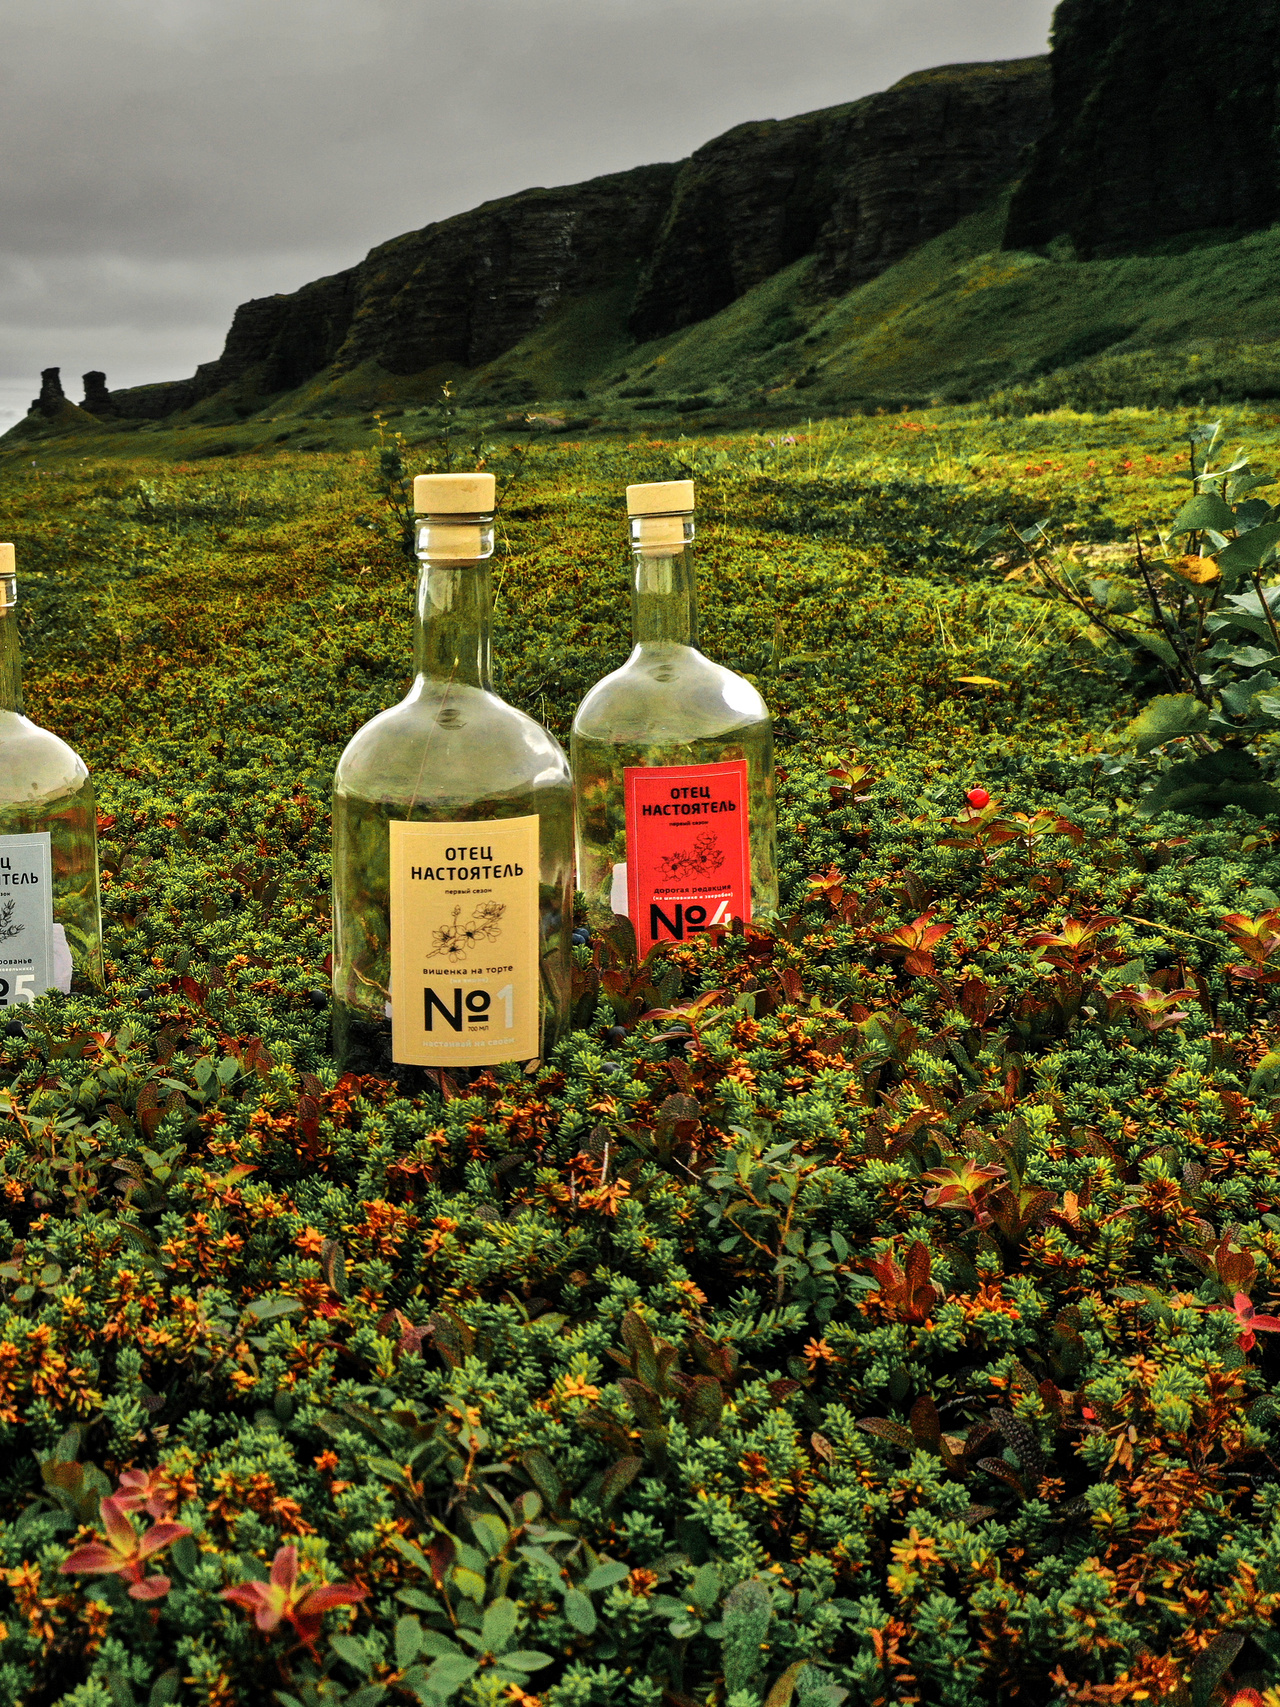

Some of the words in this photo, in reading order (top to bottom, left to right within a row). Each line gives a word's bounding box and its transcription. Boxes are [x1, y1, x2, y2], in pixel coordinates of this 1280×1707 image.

[671, 786, 711, 799] ОТЕЦ
[642, 800, 736, 816] НАСТОЯТЕЛЬ
[445, 846, 493, 863] ОТЕЦ
[411, 863, 524, 881] НАСТОЯТЕЛЬ
[444, 888, 471, 896] первый
[472, 887, 493, 895] сезон
[654, 887, 690, 895] дорогая
[692, 884, 731, 894] редакция
[486, 965, 514, 974] торте
